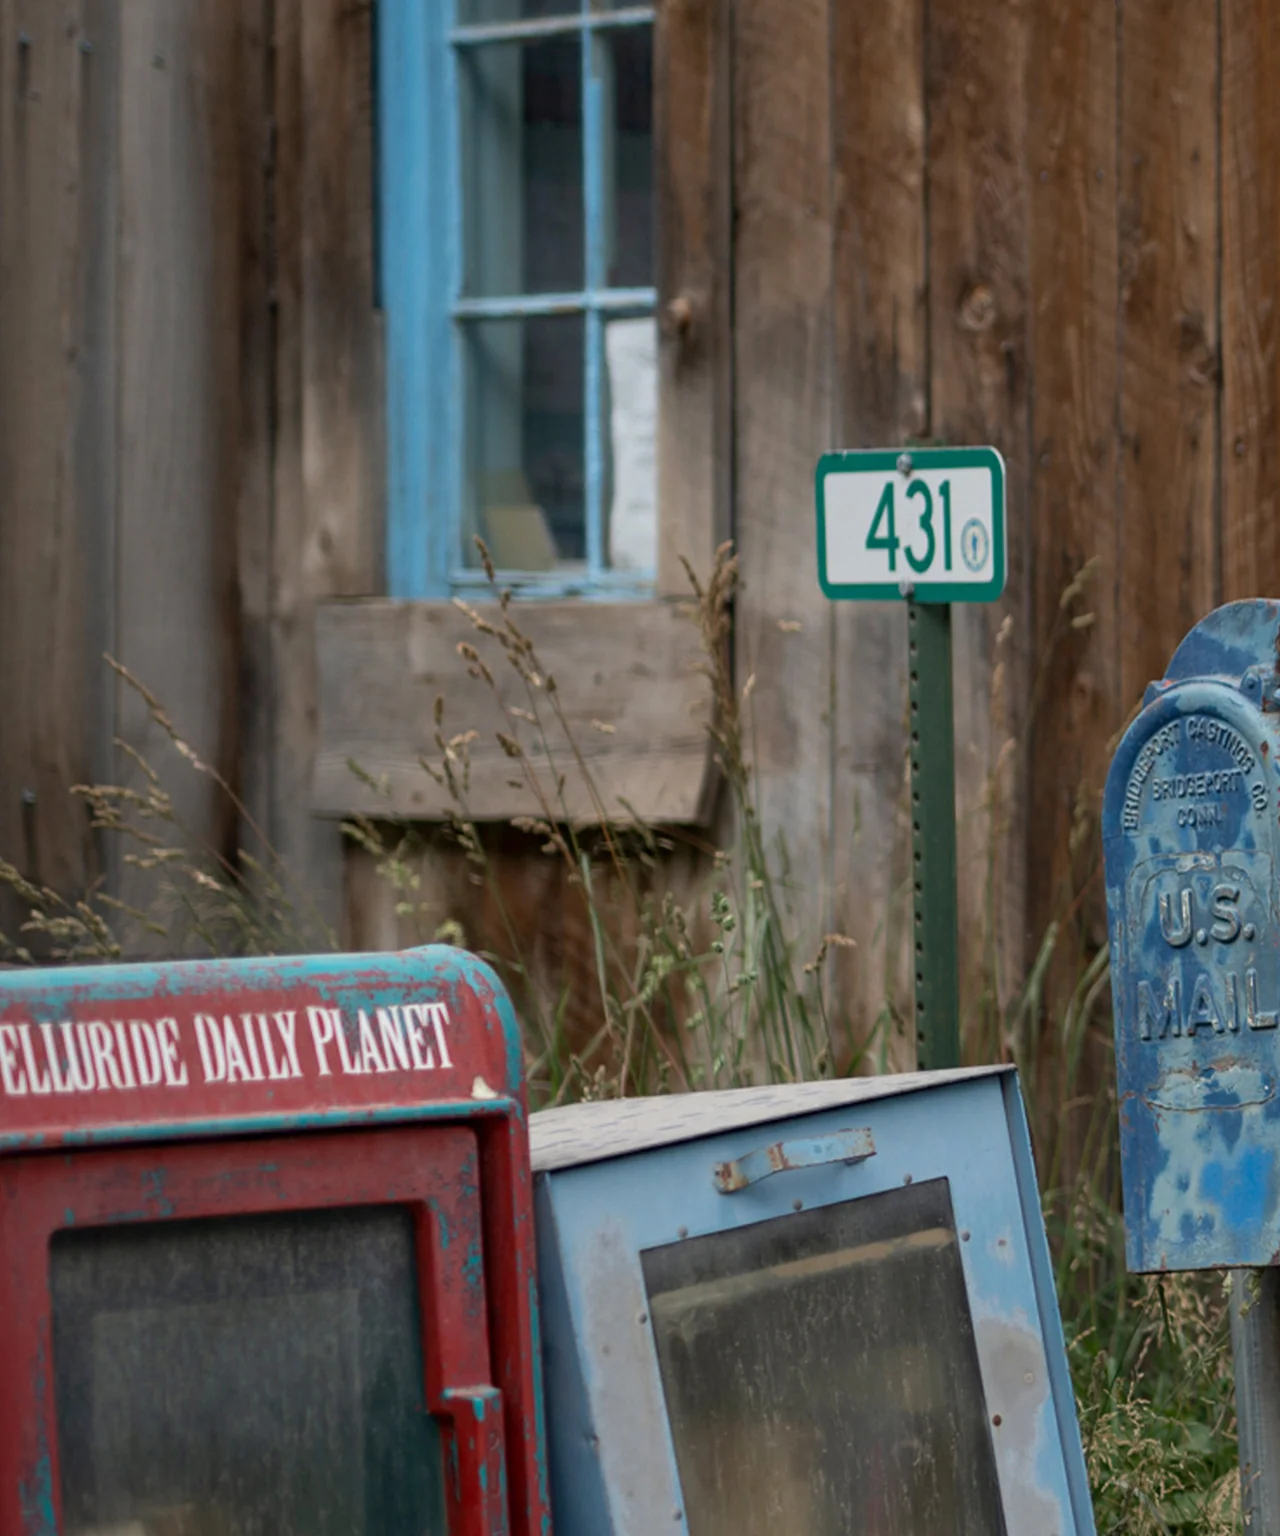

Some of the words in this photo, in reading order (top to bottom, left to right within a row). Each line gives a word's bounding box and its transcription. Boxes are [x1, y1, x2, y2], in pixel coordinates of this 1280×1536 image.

[865, 478, 952, 573] 431
[1123, 721, 1181, 831] BRIDGEPORT
[1186, 716, 1256, 776] CASTINGS
[1152, 766, 1243, 800] BRIDGEPORT
[1159, 883, 1256, 947] U.S.
[1137, 968, 1280, 1040] MAIL
[0, 1017, 189, 1095] ELLURIDE
[193, 1011, 304, 1084] DAILY
[305, 1002, 454, 1077] PLANET
